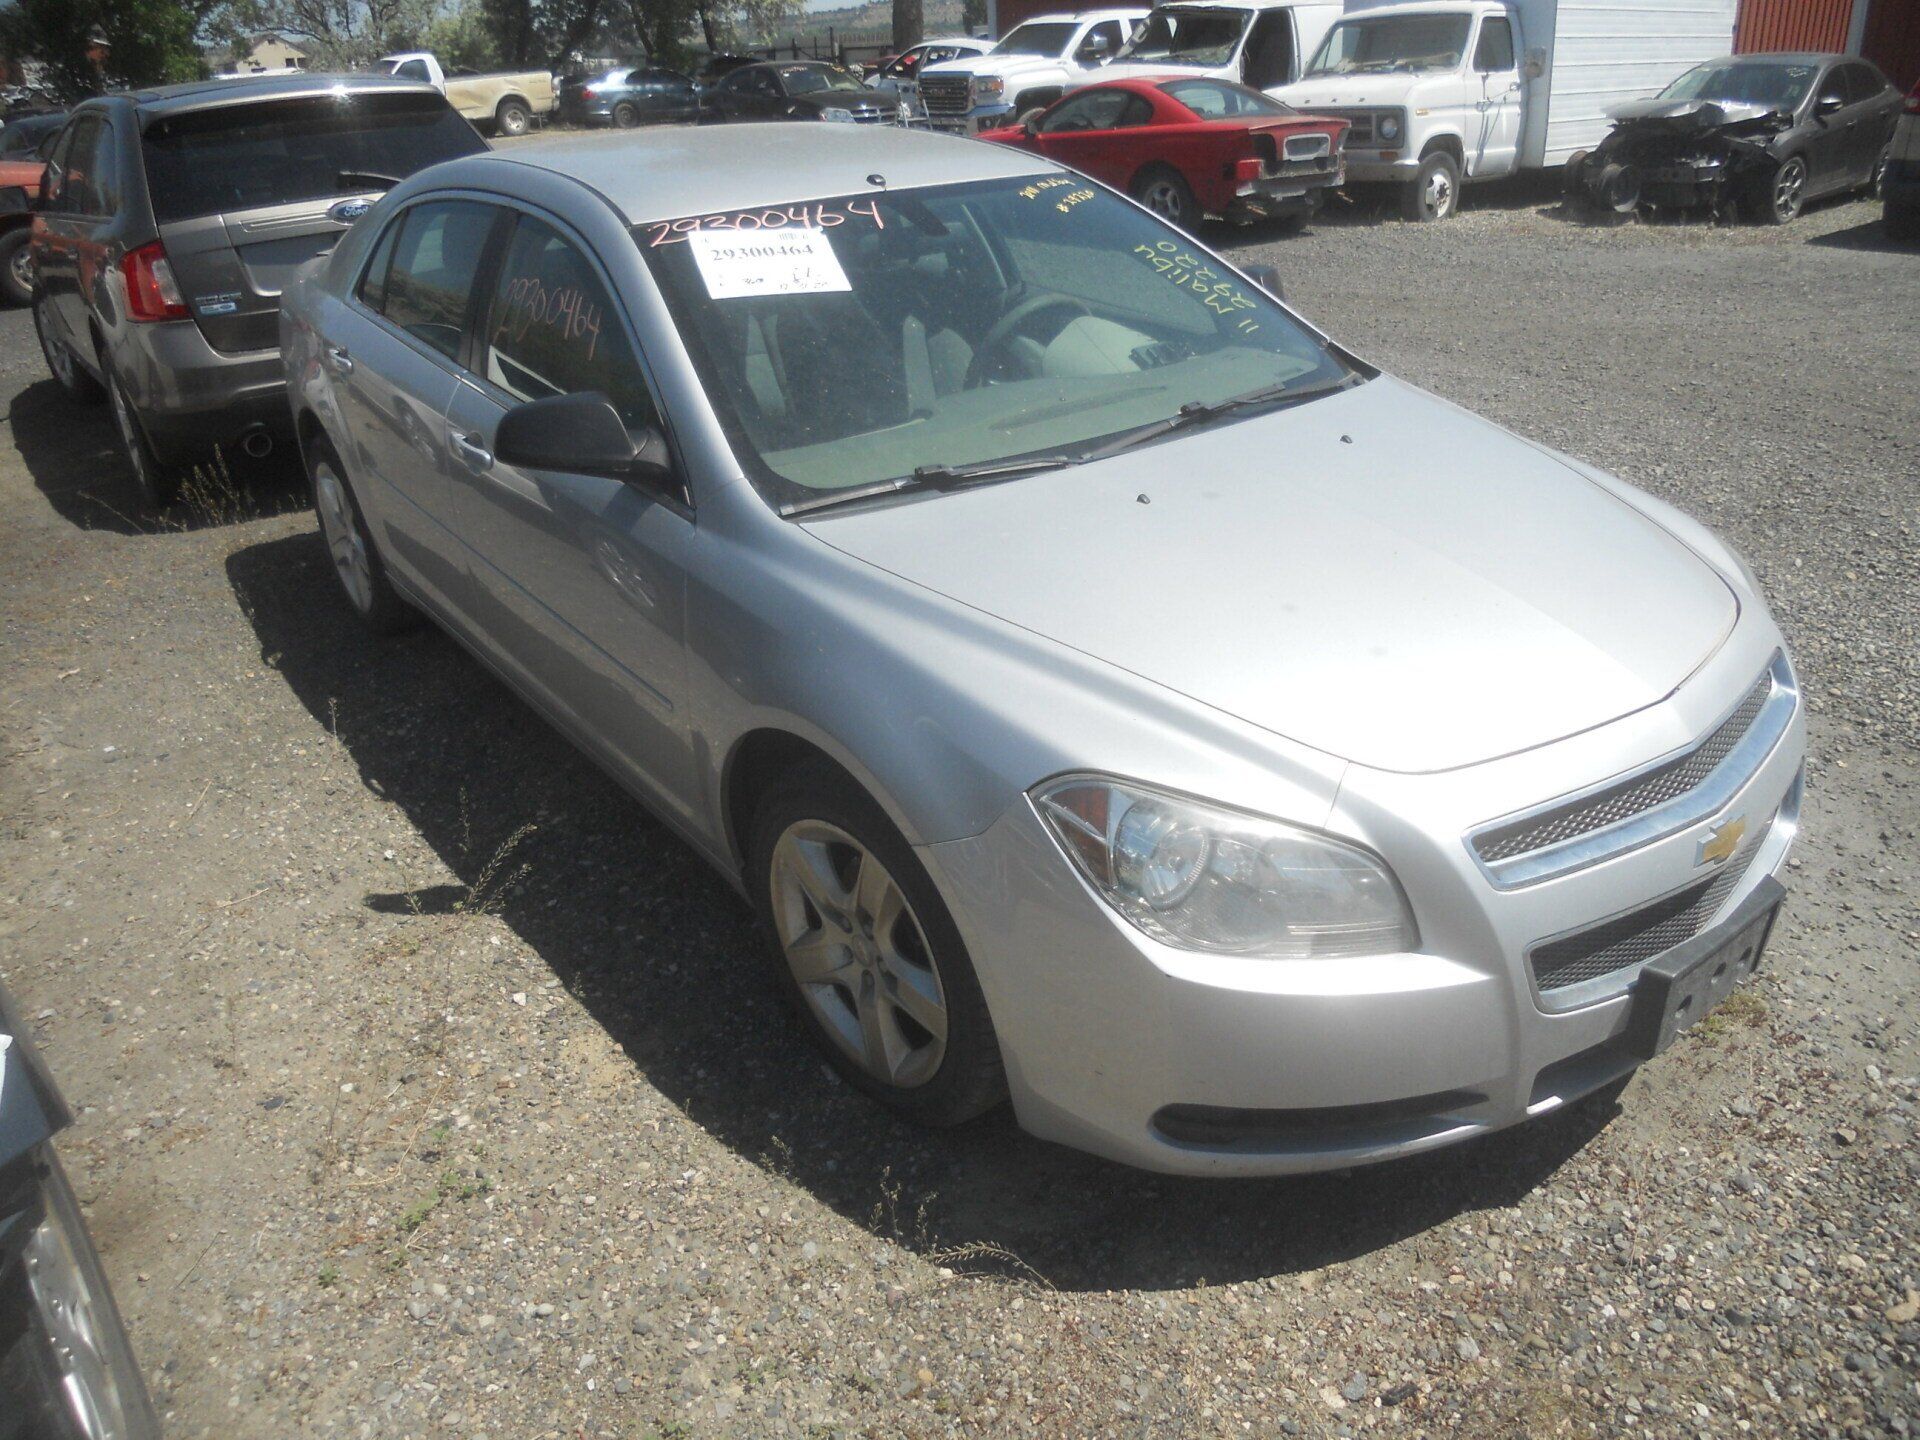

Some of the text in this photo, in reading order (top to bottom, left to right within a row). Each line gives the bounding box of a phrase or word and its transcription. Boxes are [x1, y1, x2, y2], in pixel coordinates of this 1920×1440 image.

[711, 244, 814, 261] 29300464
[1134, 244, 1235, 314] Malibu
[1156, 241, 1257, 309] 29220
